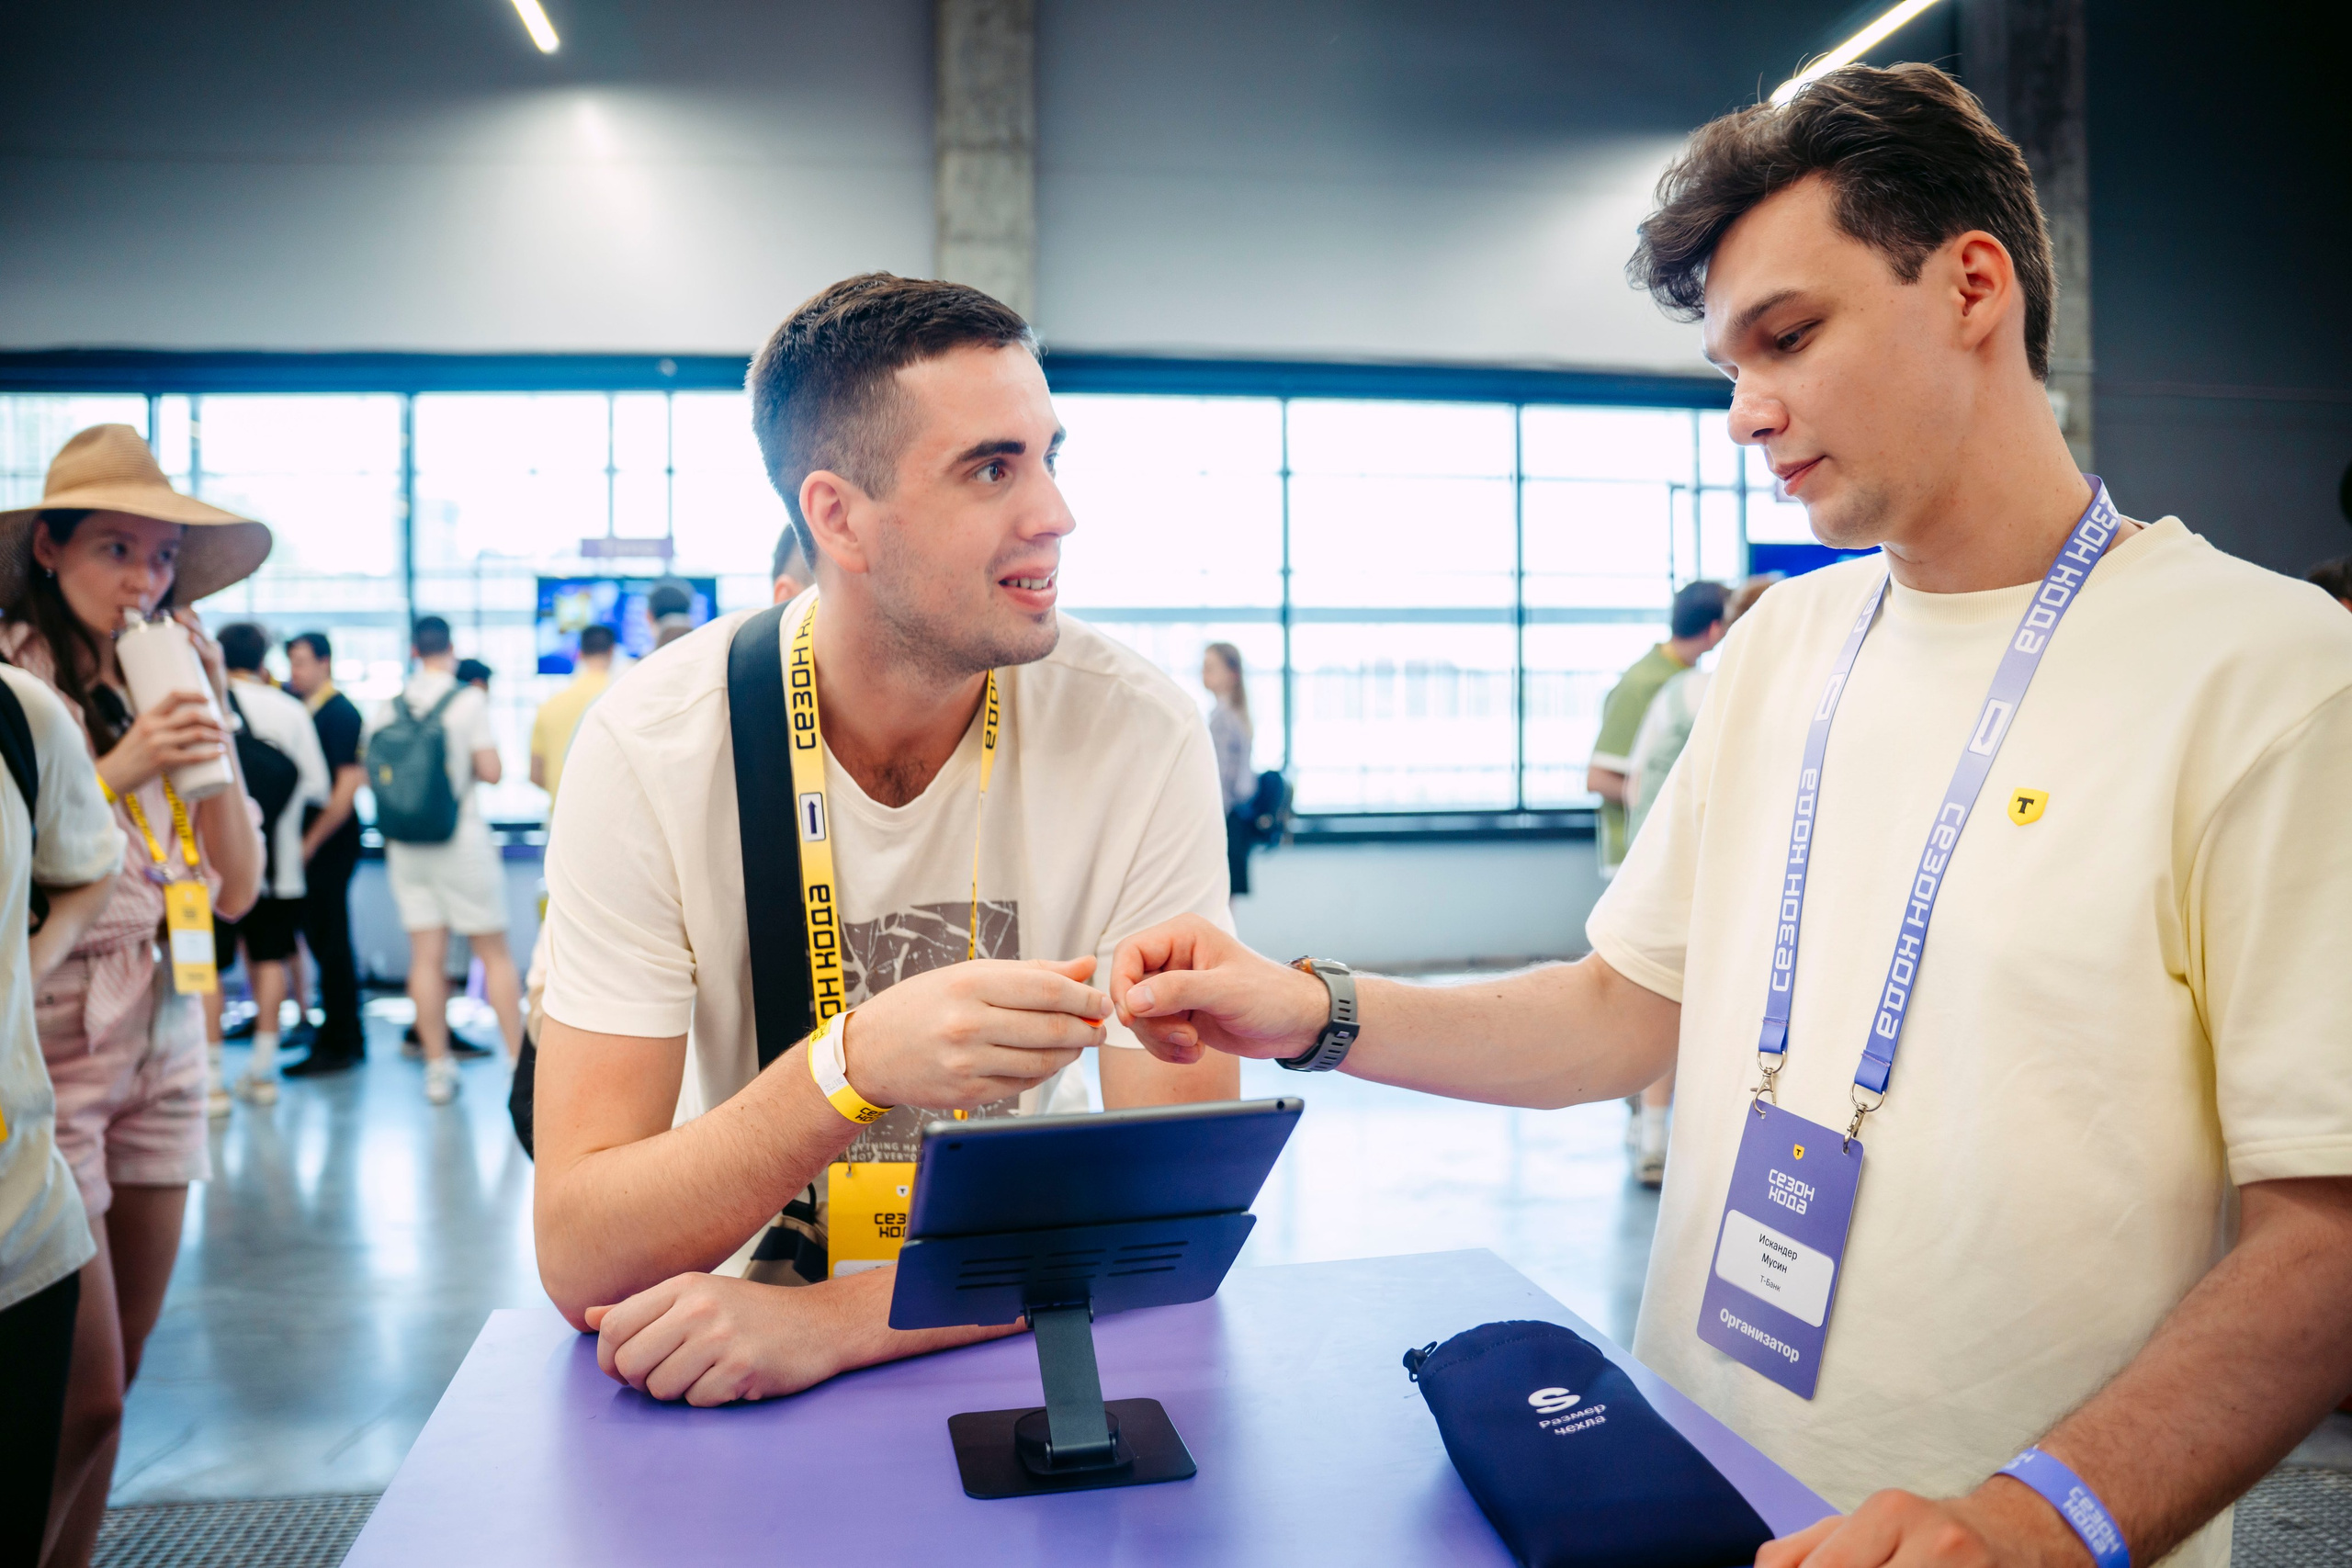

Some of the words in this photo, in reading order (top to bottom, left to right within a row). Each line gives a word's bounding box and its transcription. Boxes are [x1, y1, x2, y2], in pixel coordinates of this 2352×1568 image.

[875, 1213, 907, 1224] сез
[1758, 1234, 1798, 1261] Искандер
[1761, 1253, 1787, 1273] Мусин
[1760, 1275, 1781, 1292] Т-Банк
[1720, 1307, 1800, 1364] Организатор
[1528, 1387, 1580, 1414] S
[1539, 1404, 1607, 1429] Размер
[1554, 1416, 1607, 1436] чехла
